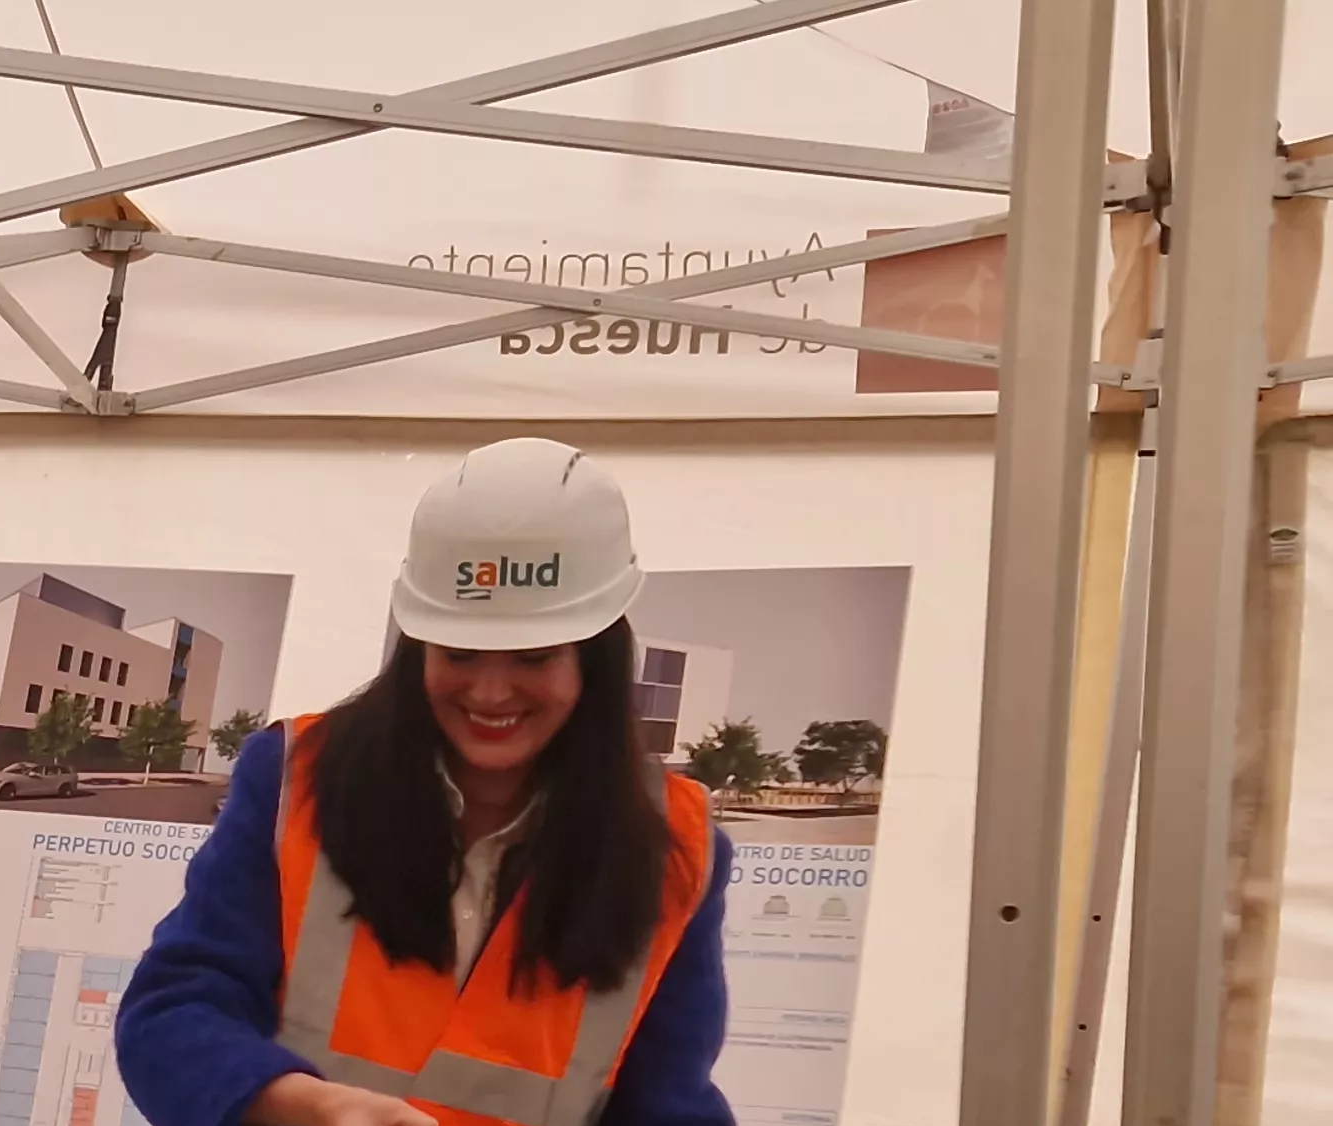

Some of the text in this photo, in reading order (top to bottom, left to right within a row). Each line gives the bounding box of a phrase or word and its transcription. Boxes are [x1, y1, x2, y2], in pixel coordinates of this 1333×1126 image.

[455, 552, 560, 587] salud
[104, 820, 162, 837] CENTRO
[167, 825, 187, 839] DE
[33, 834, 135, 858] PERPETUO
[781, 846, 803, 861] DE
[809, 847, 871, 862] SALUD
[751, 866, 868, 888] SOCORRO
